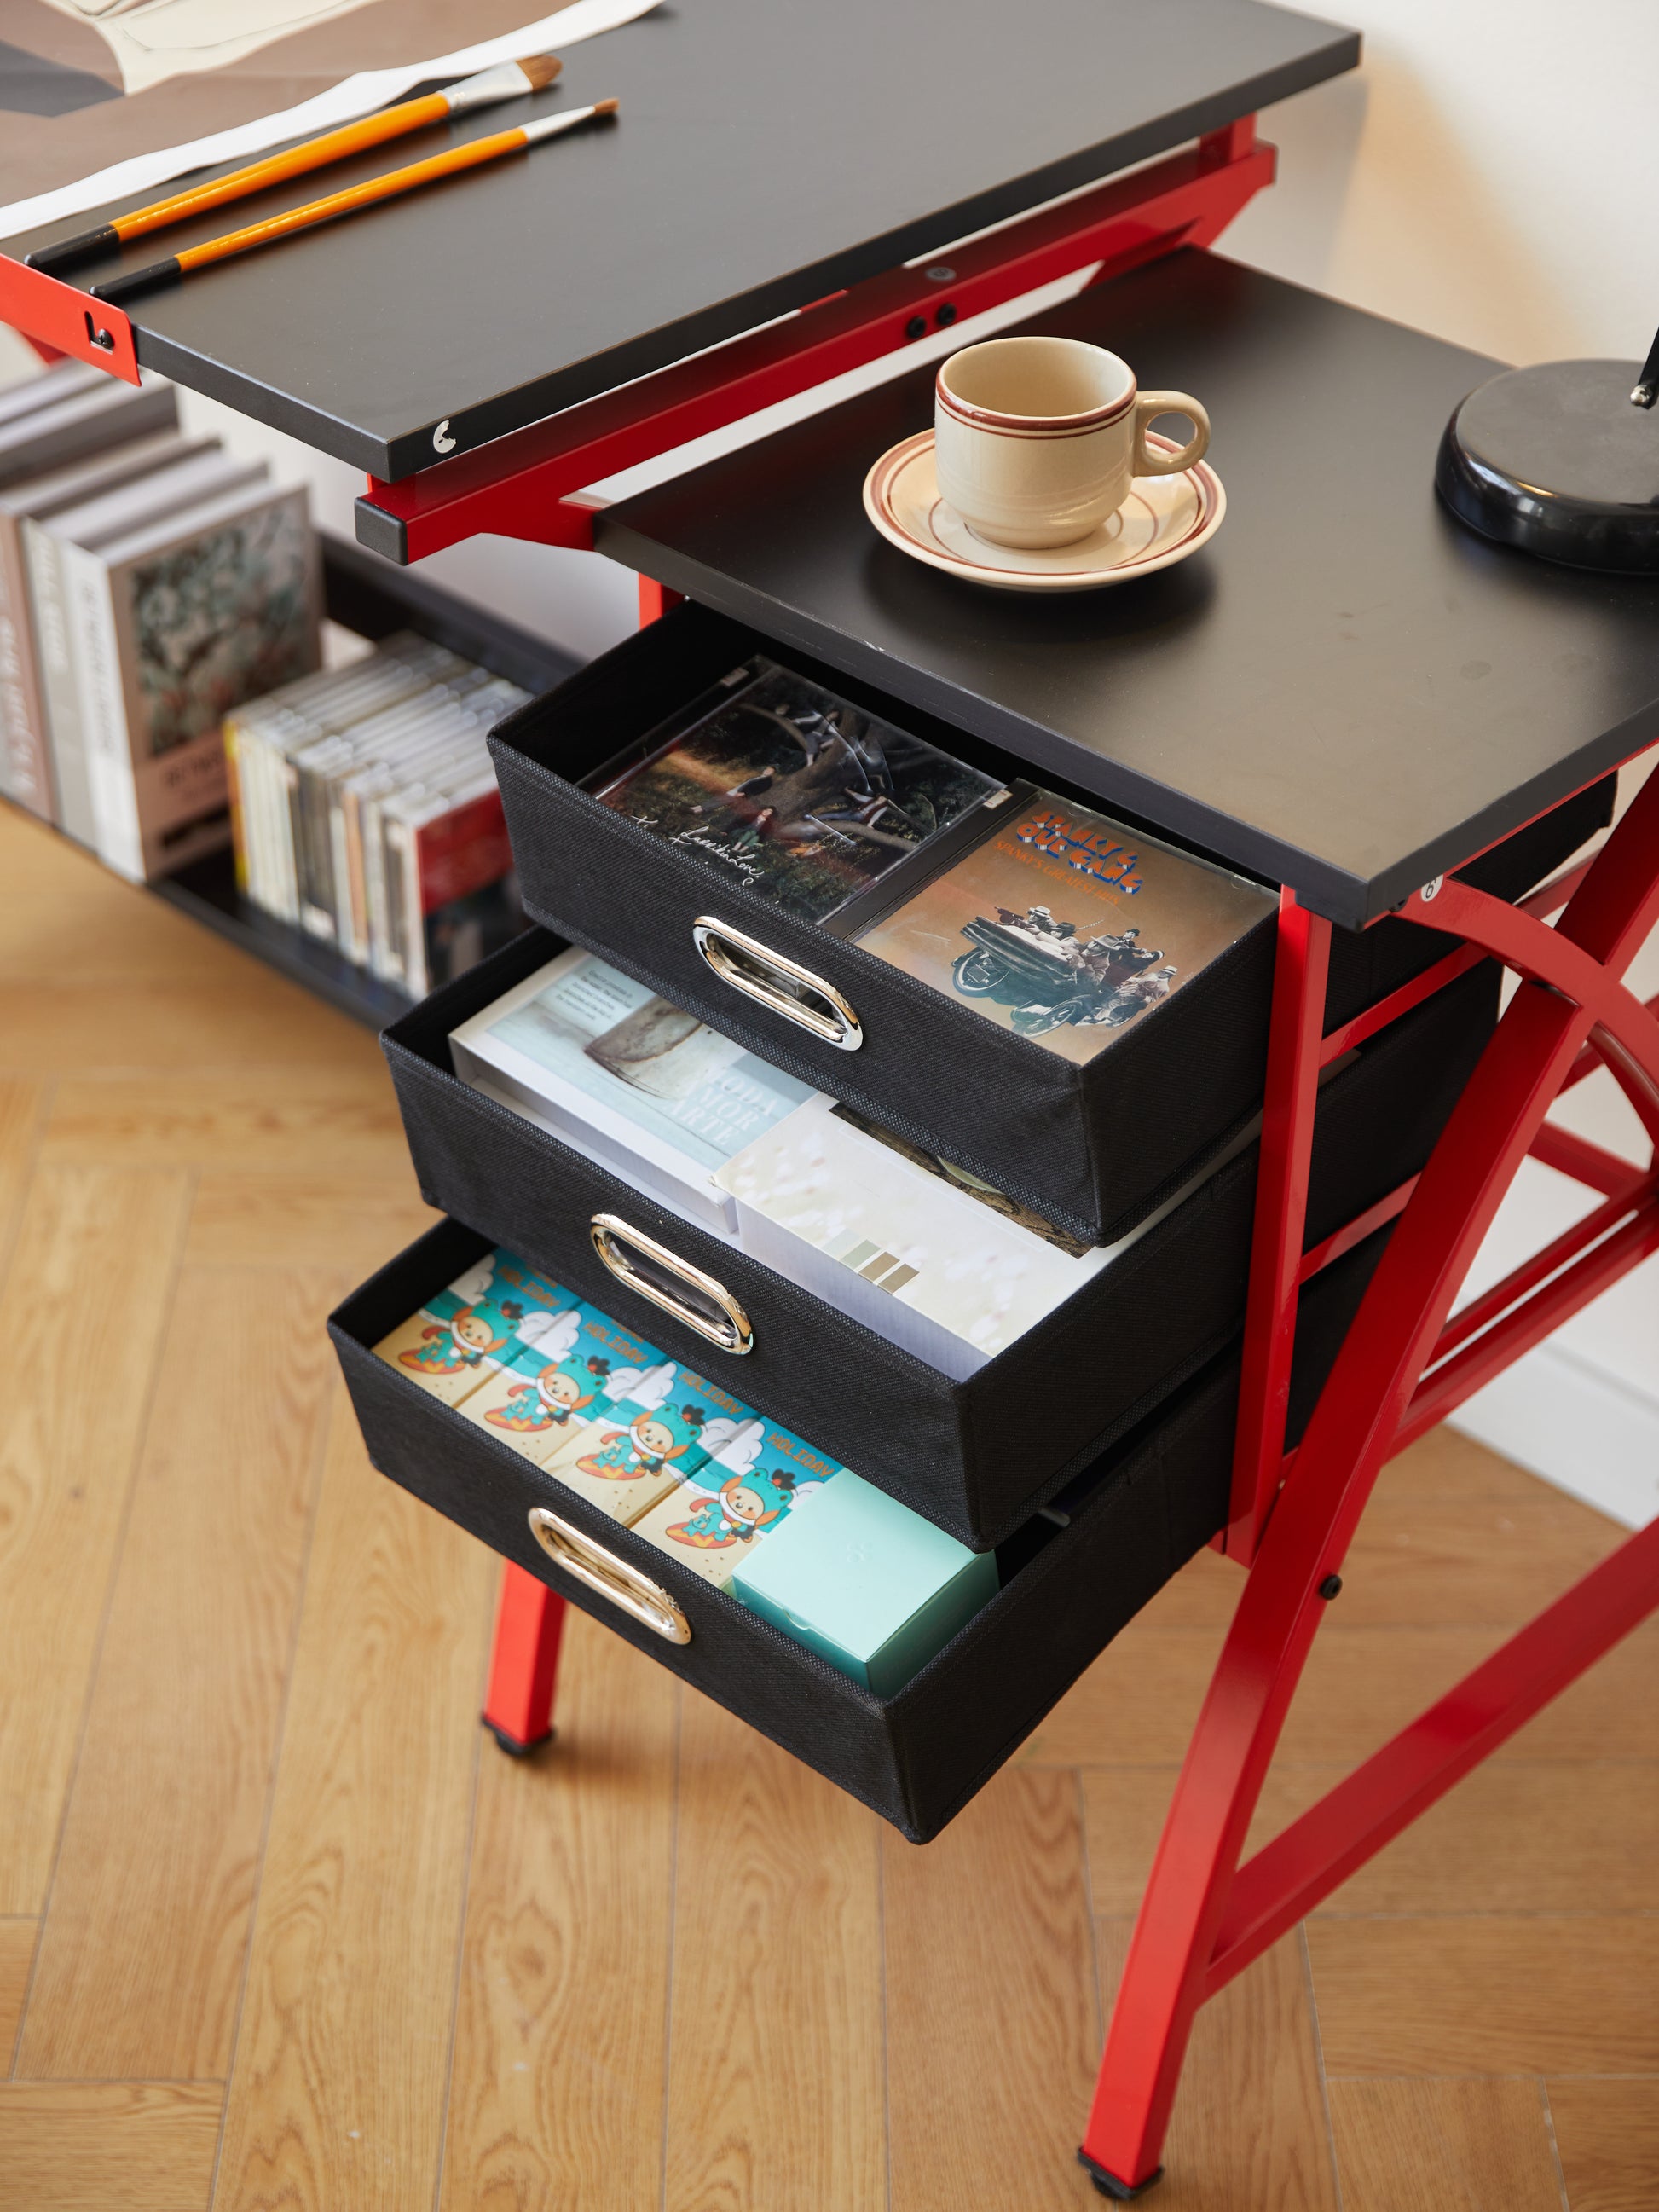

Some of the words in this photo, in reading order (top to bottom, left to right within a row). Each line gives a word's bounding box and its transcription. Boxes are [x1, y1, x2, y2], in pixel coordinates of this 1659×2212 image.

[1032, 811, 1124, 860] SPANKY
[1016, 822, 1067, 859] OUR
[1069, 849, 1143, 895] GANG
[497, 1265, 561, 1308] HOLIDAY
[582, 1321, 648, 1364] HOLIDAY
[678, 1370, 743, 1415] HOLIDAY
[766, 1432, 835, 1477] HOLIDAY
